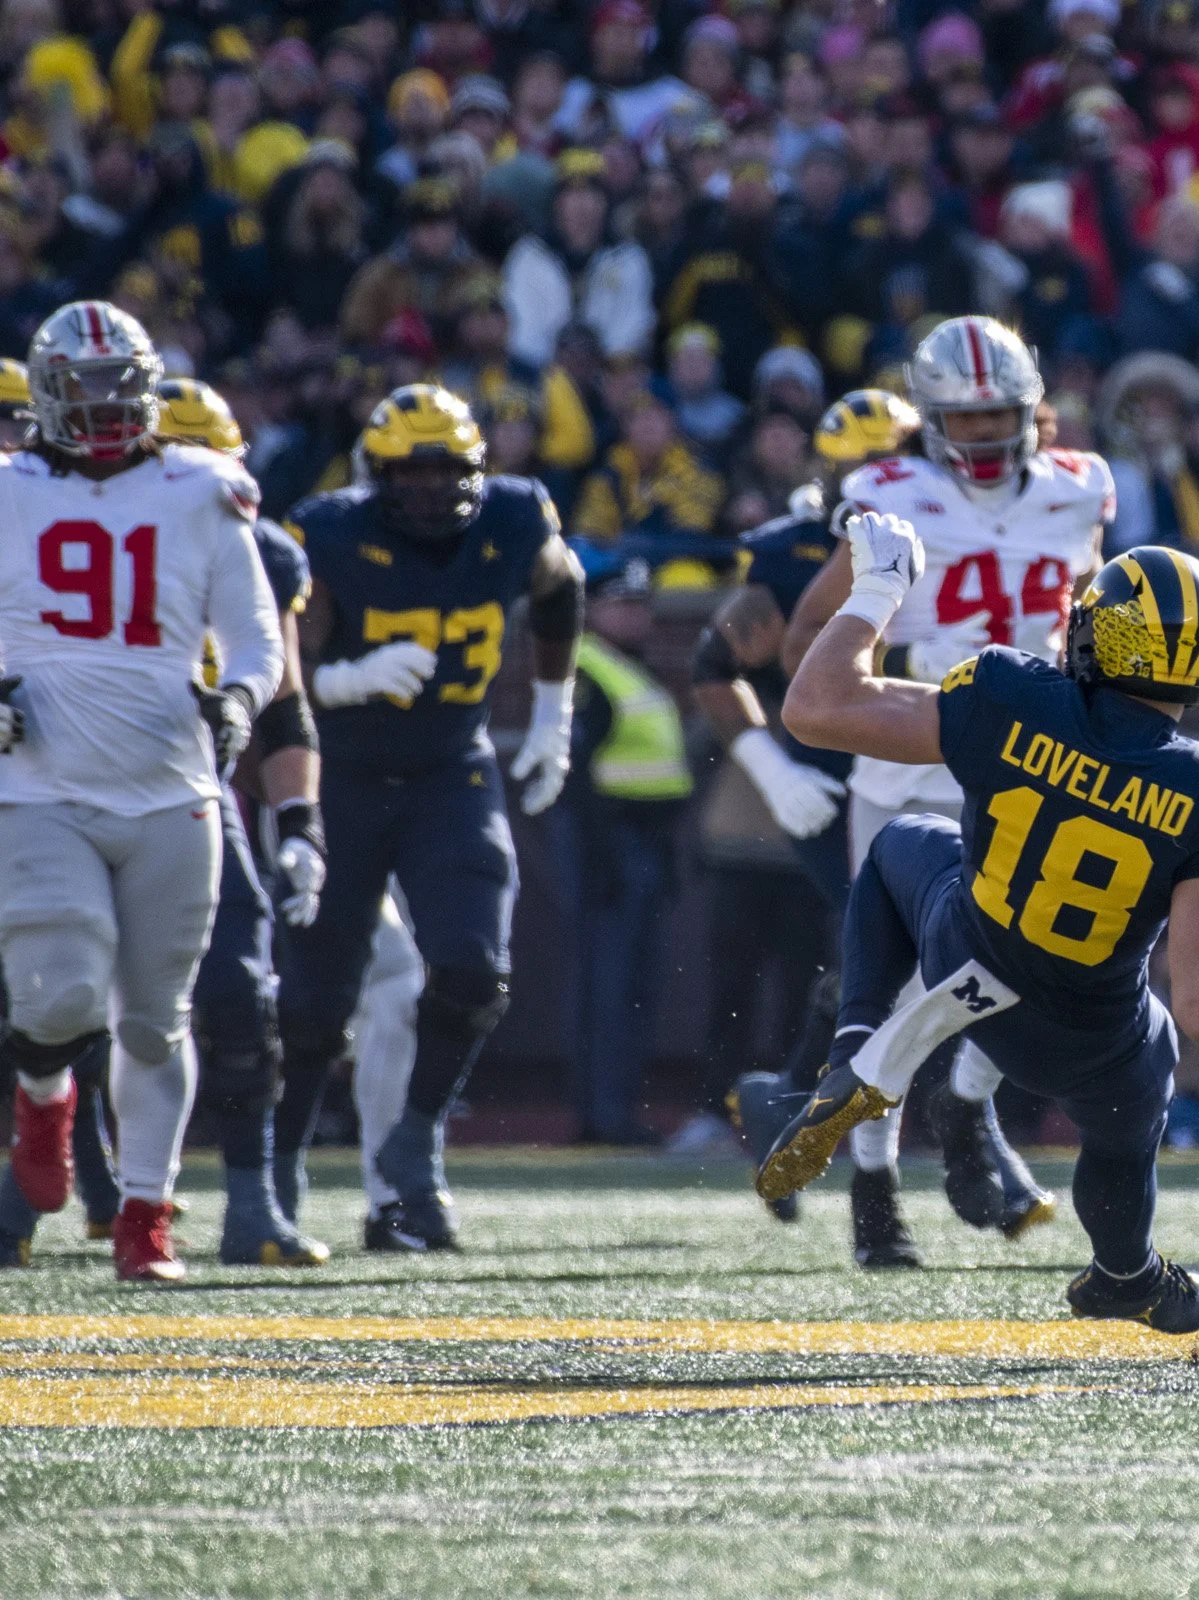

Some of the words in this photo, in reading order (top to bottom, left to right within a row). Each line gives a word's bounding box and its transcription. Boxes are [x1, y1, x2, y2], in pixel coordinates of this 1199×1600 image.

[37, 518, 163, 647] 91
[362, 602, 506, 710] 73
[1001, 720, 1195, 837] LOVELAND
[971, 785, 1154, 967] 18
[951, 974, 998, 1014] M
